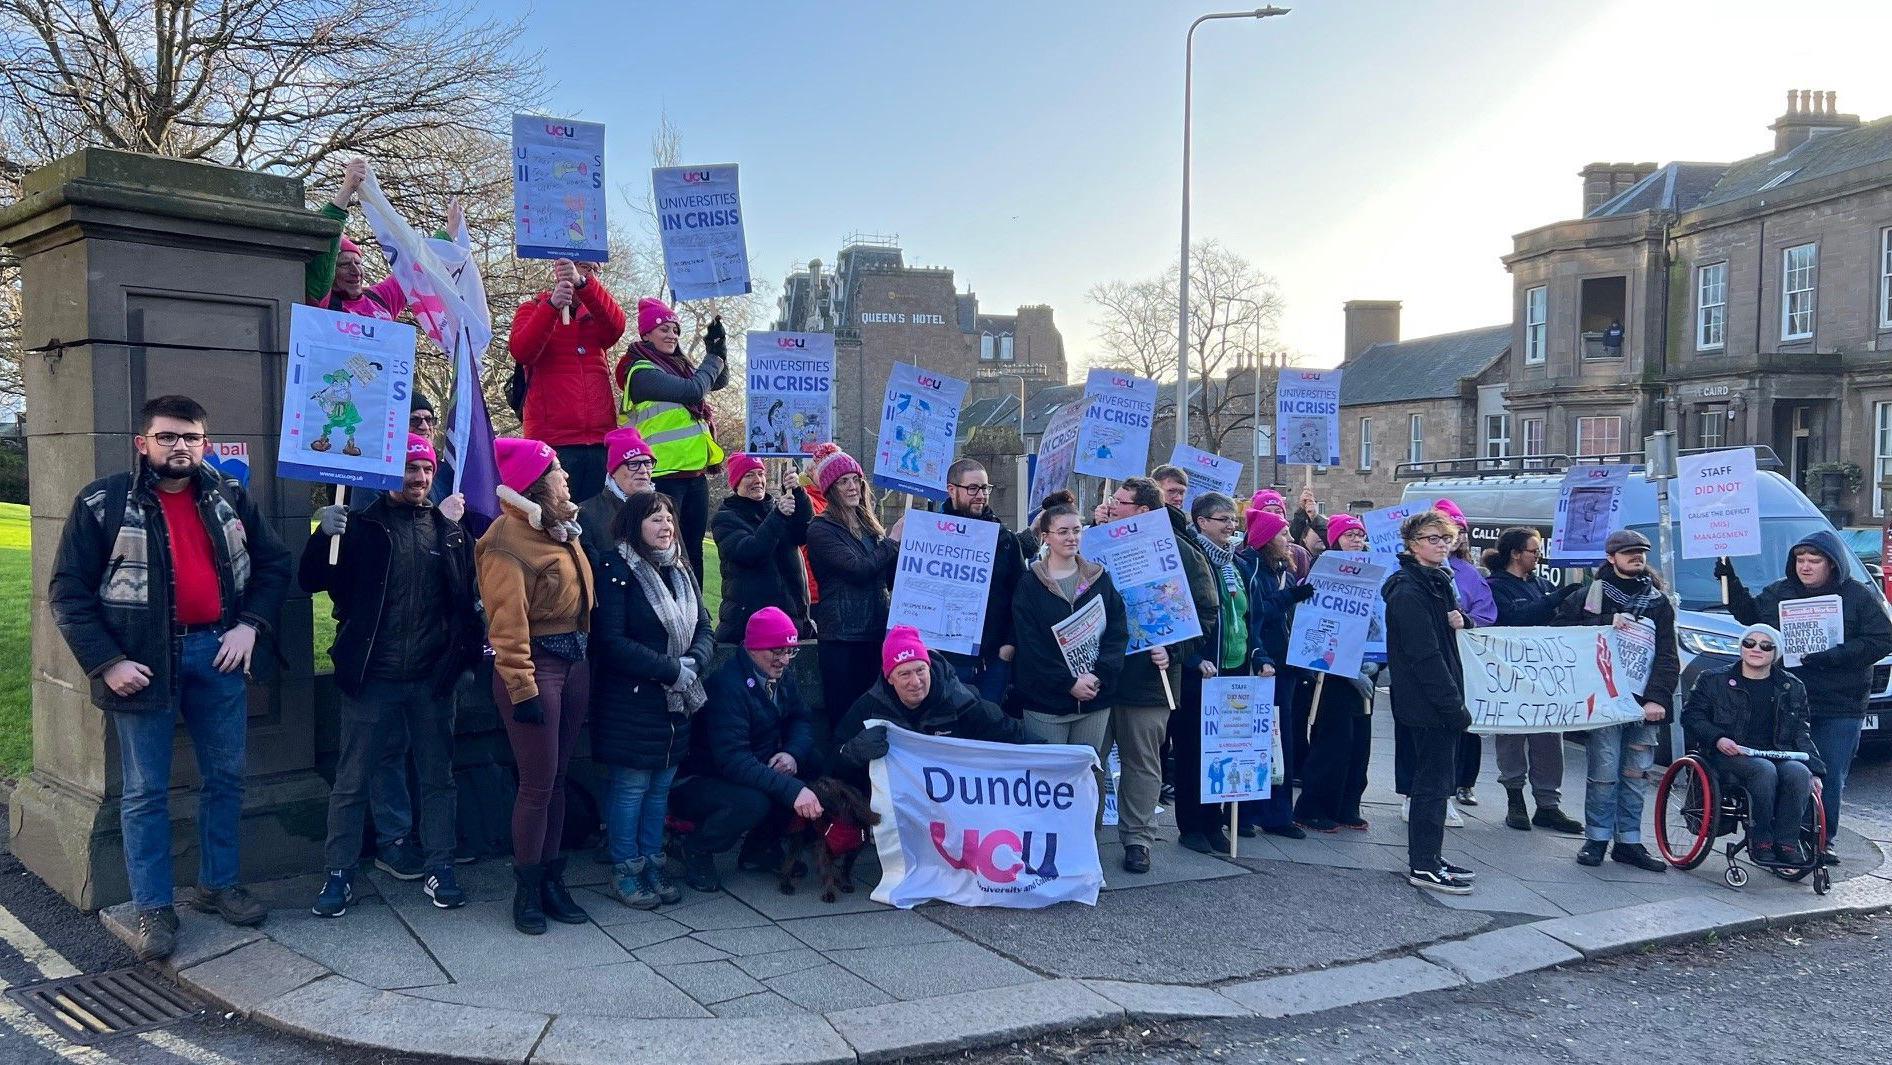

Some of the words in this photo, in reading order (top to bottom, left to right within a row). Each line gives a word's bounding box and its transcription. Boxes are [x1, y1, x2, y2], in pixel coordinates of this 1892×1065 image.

[659, 193, 737, 210] UNIVERSITIES
[662, 213, 682, 230] IN
[684, 209, 739, 229] CRISIS
[862, 312, 905, 324] QUEEN'S
[913, 313, 946, 325] HOTEL
[750, 359, 830, 372] UNIVERSITIES
[750, 375, 769, 390] IN
[773, 376, 830, 392] CRISIS
[1280, 387, 1337, 400] UNIVERSITIES
[1703, 386, 1729, 397] CAIRD
[1087, 391, 1152, 412] UNIVERSITIES
[1280, 401, 1293, 413] IN
[1296, 401, 1336, 414] CRISIS
[1085, 405, 1101, 419] IN
[1103, 408, 1150, 428] CRISIS
[1052, 425, 1078, 450] CRISIS
[319, 471, 364, 482] www.ucu.org.uk
[1700, 466, 1733, 478] STAFF
[1695, 485, 1714, 496] DID
[1717, 481, 1742, 493] NOT
[1688, 511, 1709, 519] CAUSE
[1725, 507, 1750, 517] DEFICIT
[1472, 527, 1500, 540] CALL?
[1694, 530, 1749, 541] MANAGEMENT
[905, 539, 991, 563] UNIVERSITIES
[902, 556, 923, 573] IN
[926, 560, 987, 583] CRISIS
[1309, 577, 1374, 600] UNIVERSITIES
[1322, 595, 1369, 617] CRISIS
[1783, 621, 1819, 631] STARMER
[1784, 630, 1811, 638] WANTS
[1784, 638, 1794, 646] TO
[1796, 637, 1809, 645] PAY
[1812, 636, 1828, 644] FOR
[1617, 639, 1648, 656] TARMER
[1784, 645, 1806, 654] MORE
[1809, 644, 1827, 652] WAR
[1485, 662, 1577, 697] SUPPORT
[1625, 667, 1644, 681] WAR
[1474, 699, 1509, 726] THE
[1205, 721, 1219, 736] IN
[923, 766, 1075, 810] Dundee
